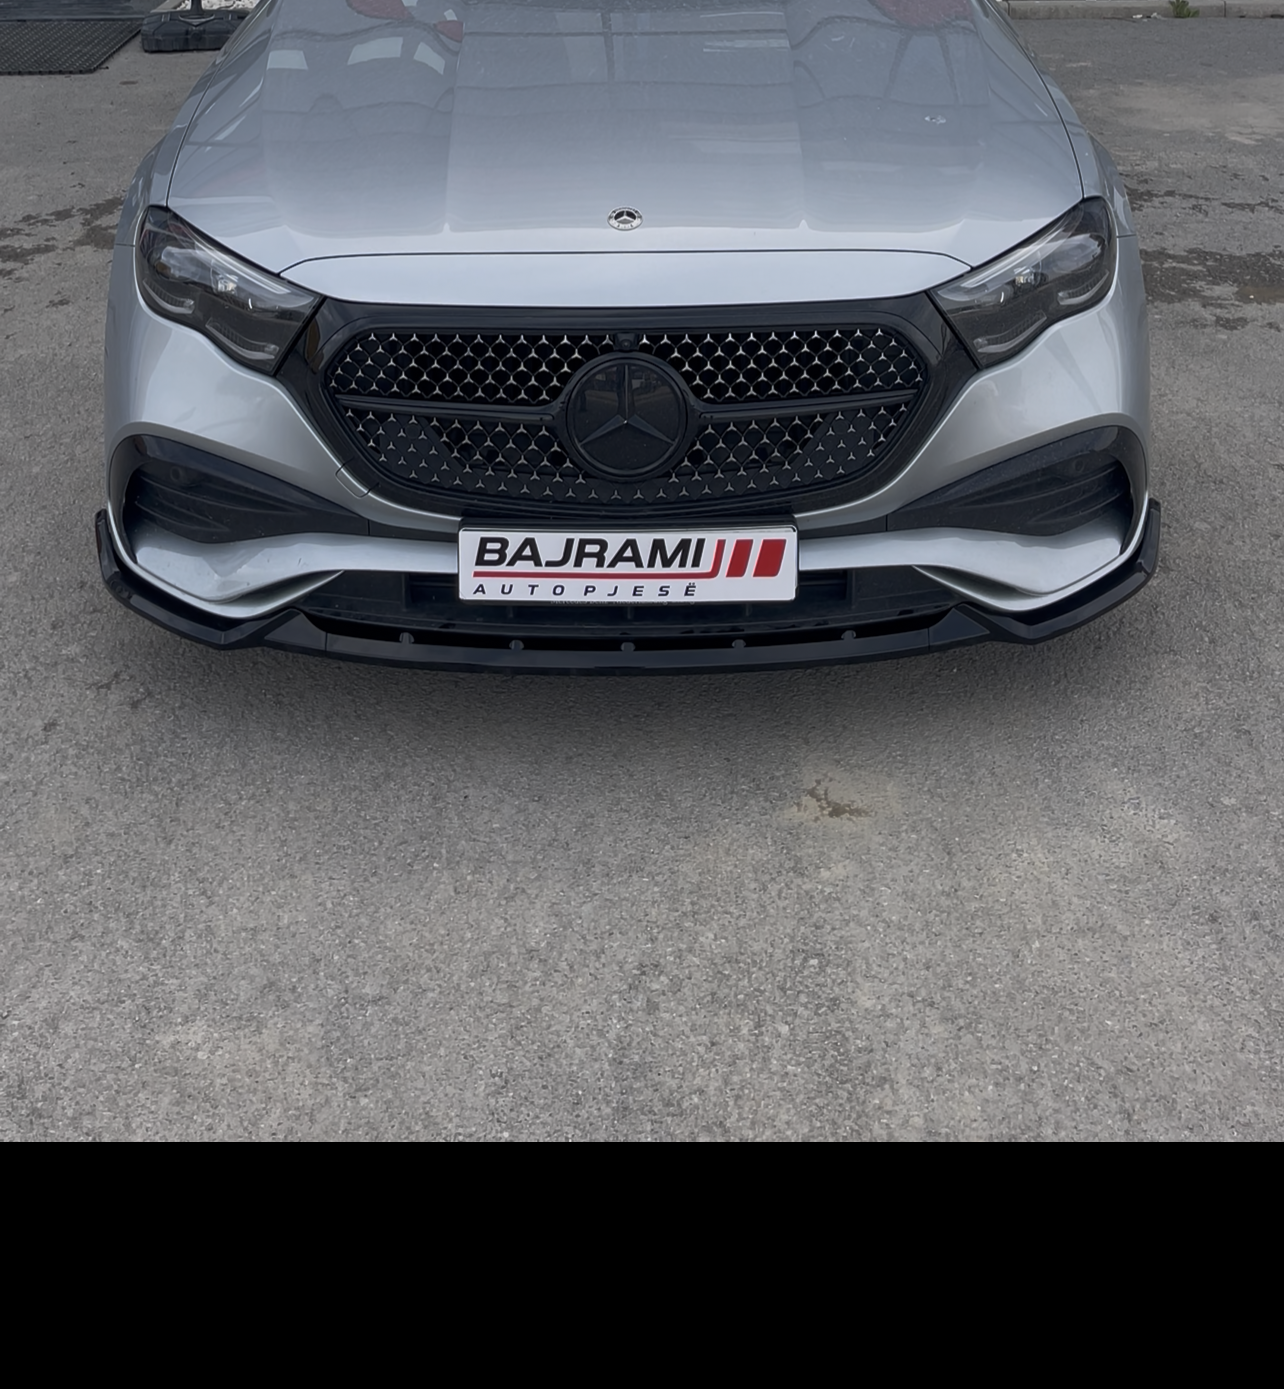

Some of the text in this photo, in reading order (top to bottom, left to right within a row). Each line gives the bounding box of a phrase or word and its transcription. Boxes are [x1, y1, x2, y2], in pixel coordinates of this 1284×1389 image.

[474, 536, 706, 569] BAJRAMI
[473, 582, 698, 598] AUTO PJESË
